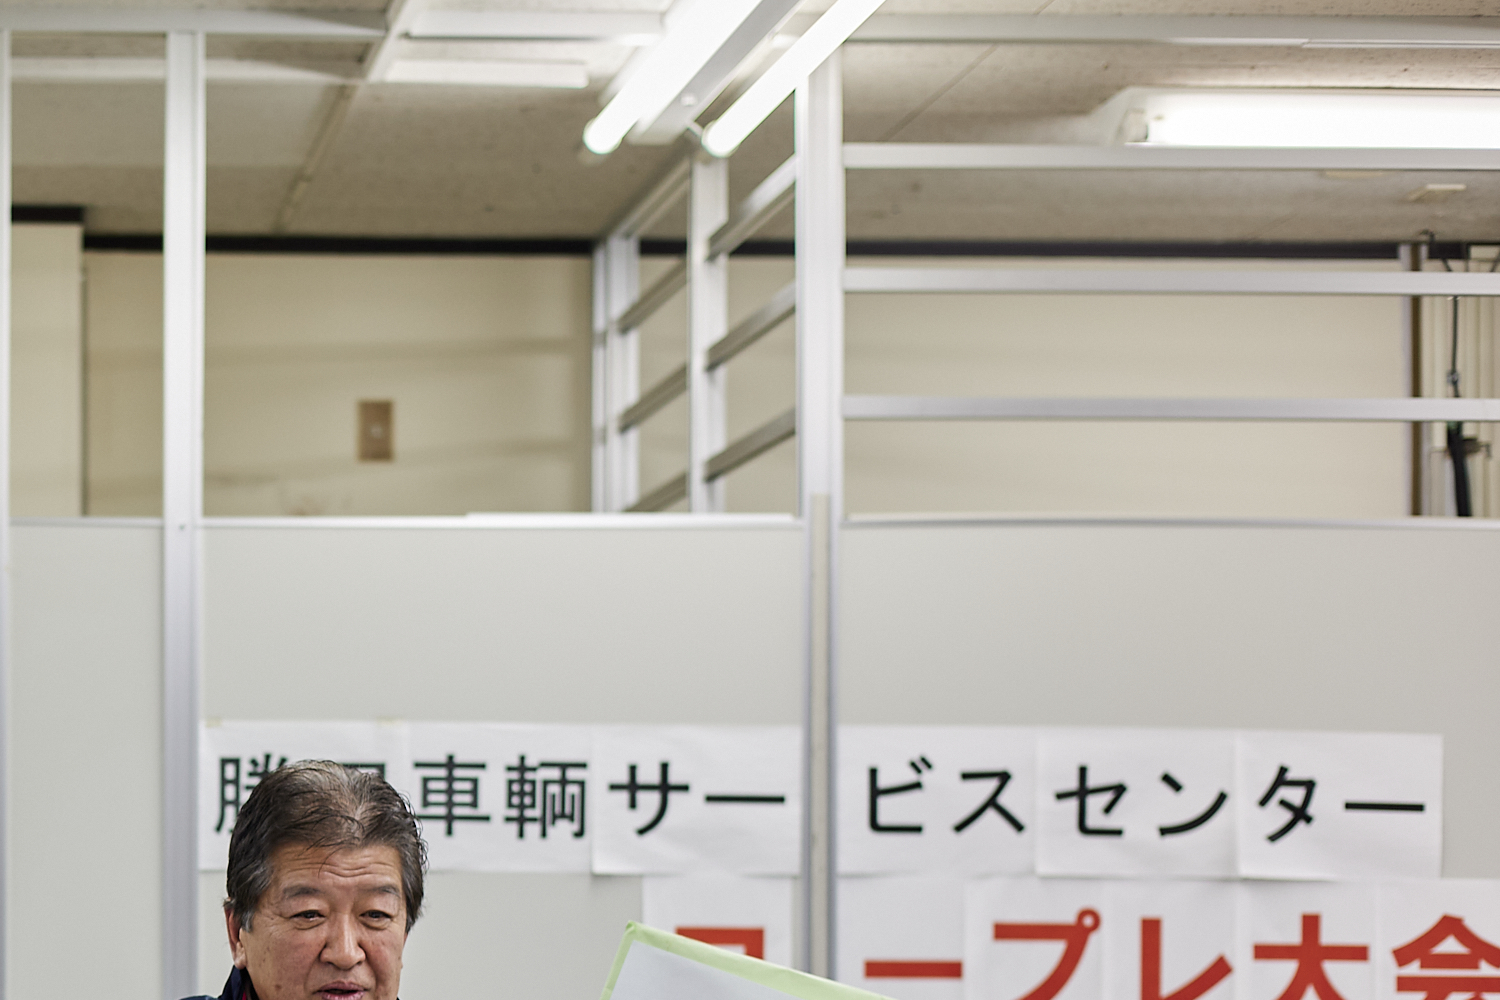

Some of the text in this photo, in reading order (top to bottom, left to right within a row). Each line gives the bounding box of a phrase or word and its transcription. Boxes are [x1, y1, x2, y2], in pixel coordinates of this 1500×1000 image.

[213, 753, 1426, 842] 車輌サービスセンター
